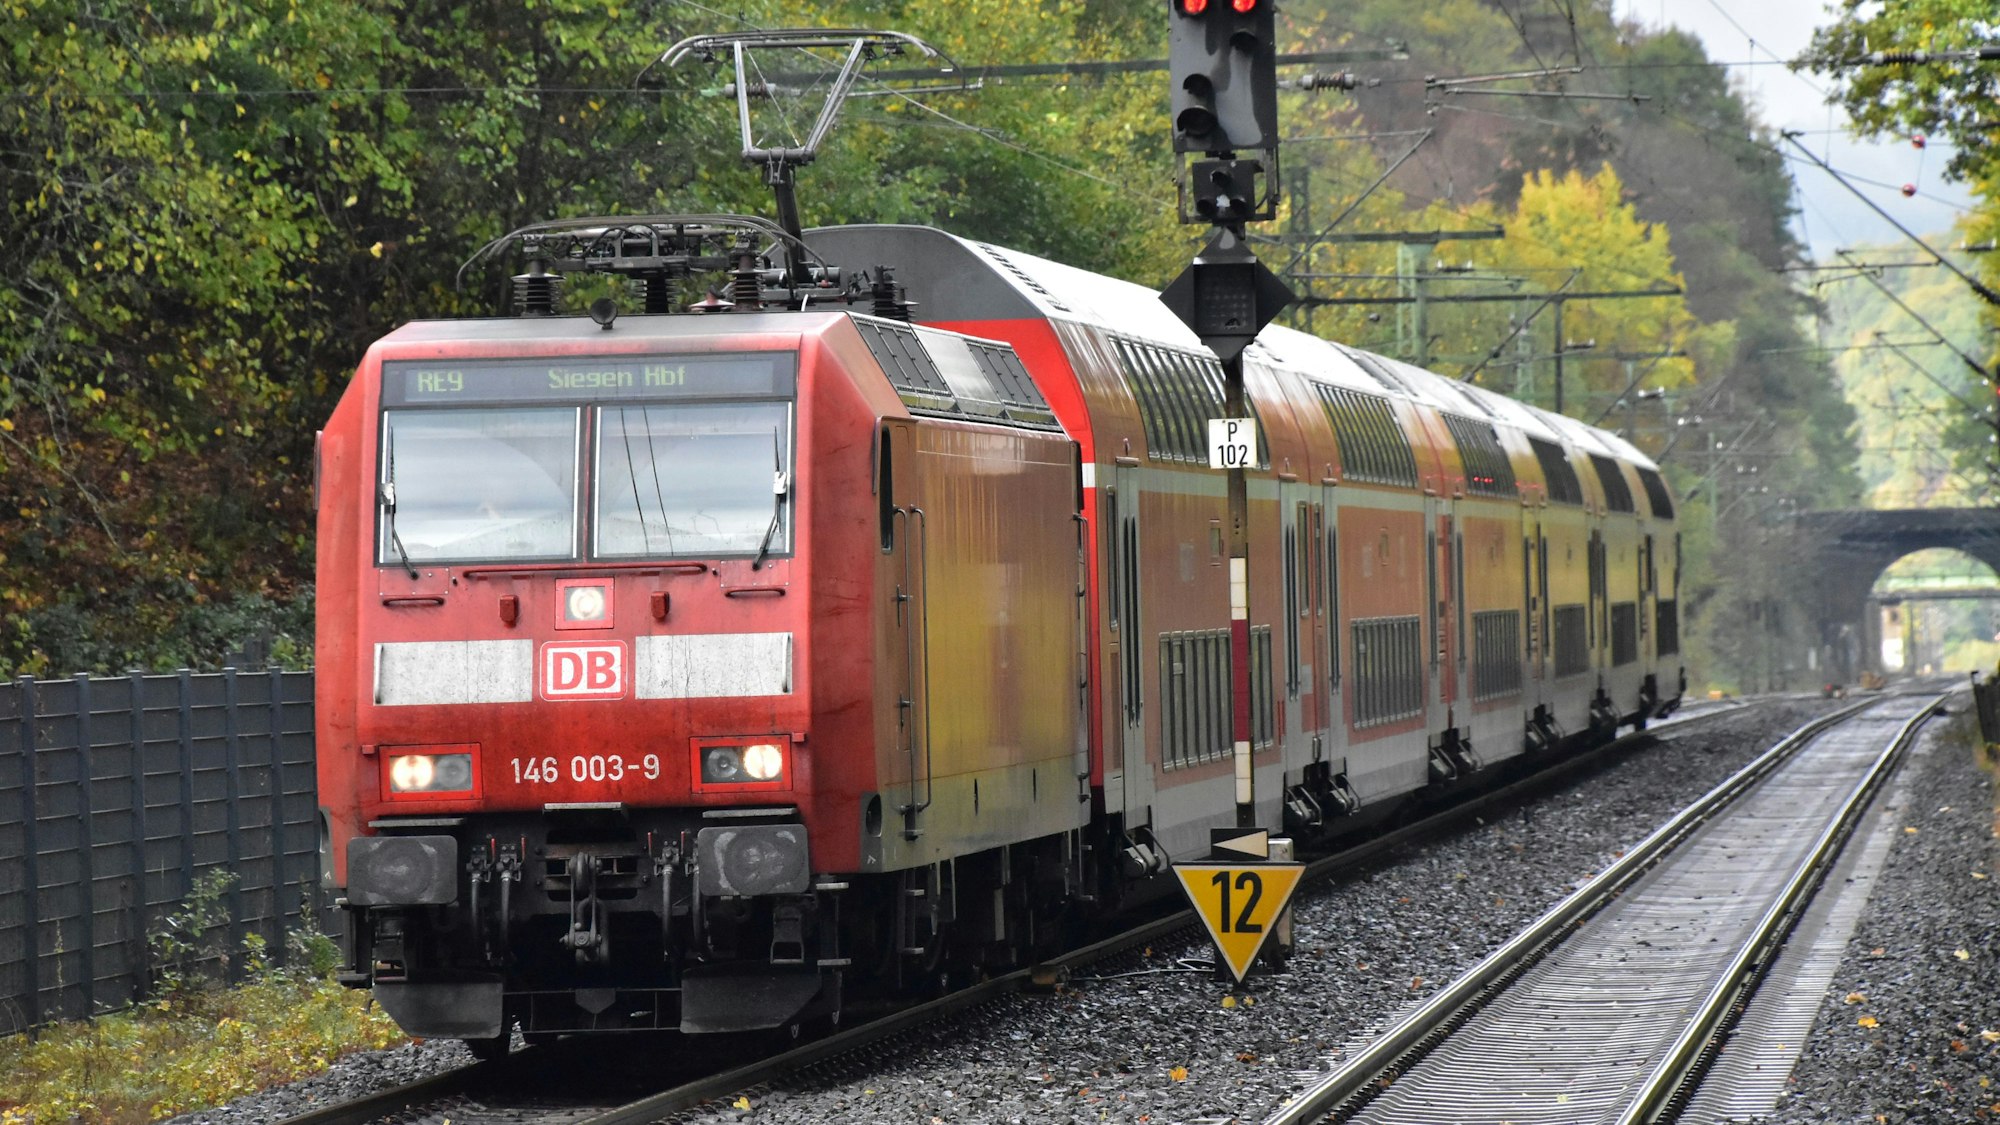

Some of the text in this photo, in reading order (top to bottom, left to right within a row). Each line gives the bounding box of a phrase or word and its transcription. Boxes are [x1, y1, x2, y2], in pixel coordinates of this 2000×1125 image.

[417, 364, 686, 392] RE9 Siegen Hbf
[1228, 421, 1238, 442] P
[1217, 444, 1248, 466] 102
[552, 650, 617, 691] DB
[510, 753, 660, 784] 146 003-9
[1211, 871, 1263, 934] 12
